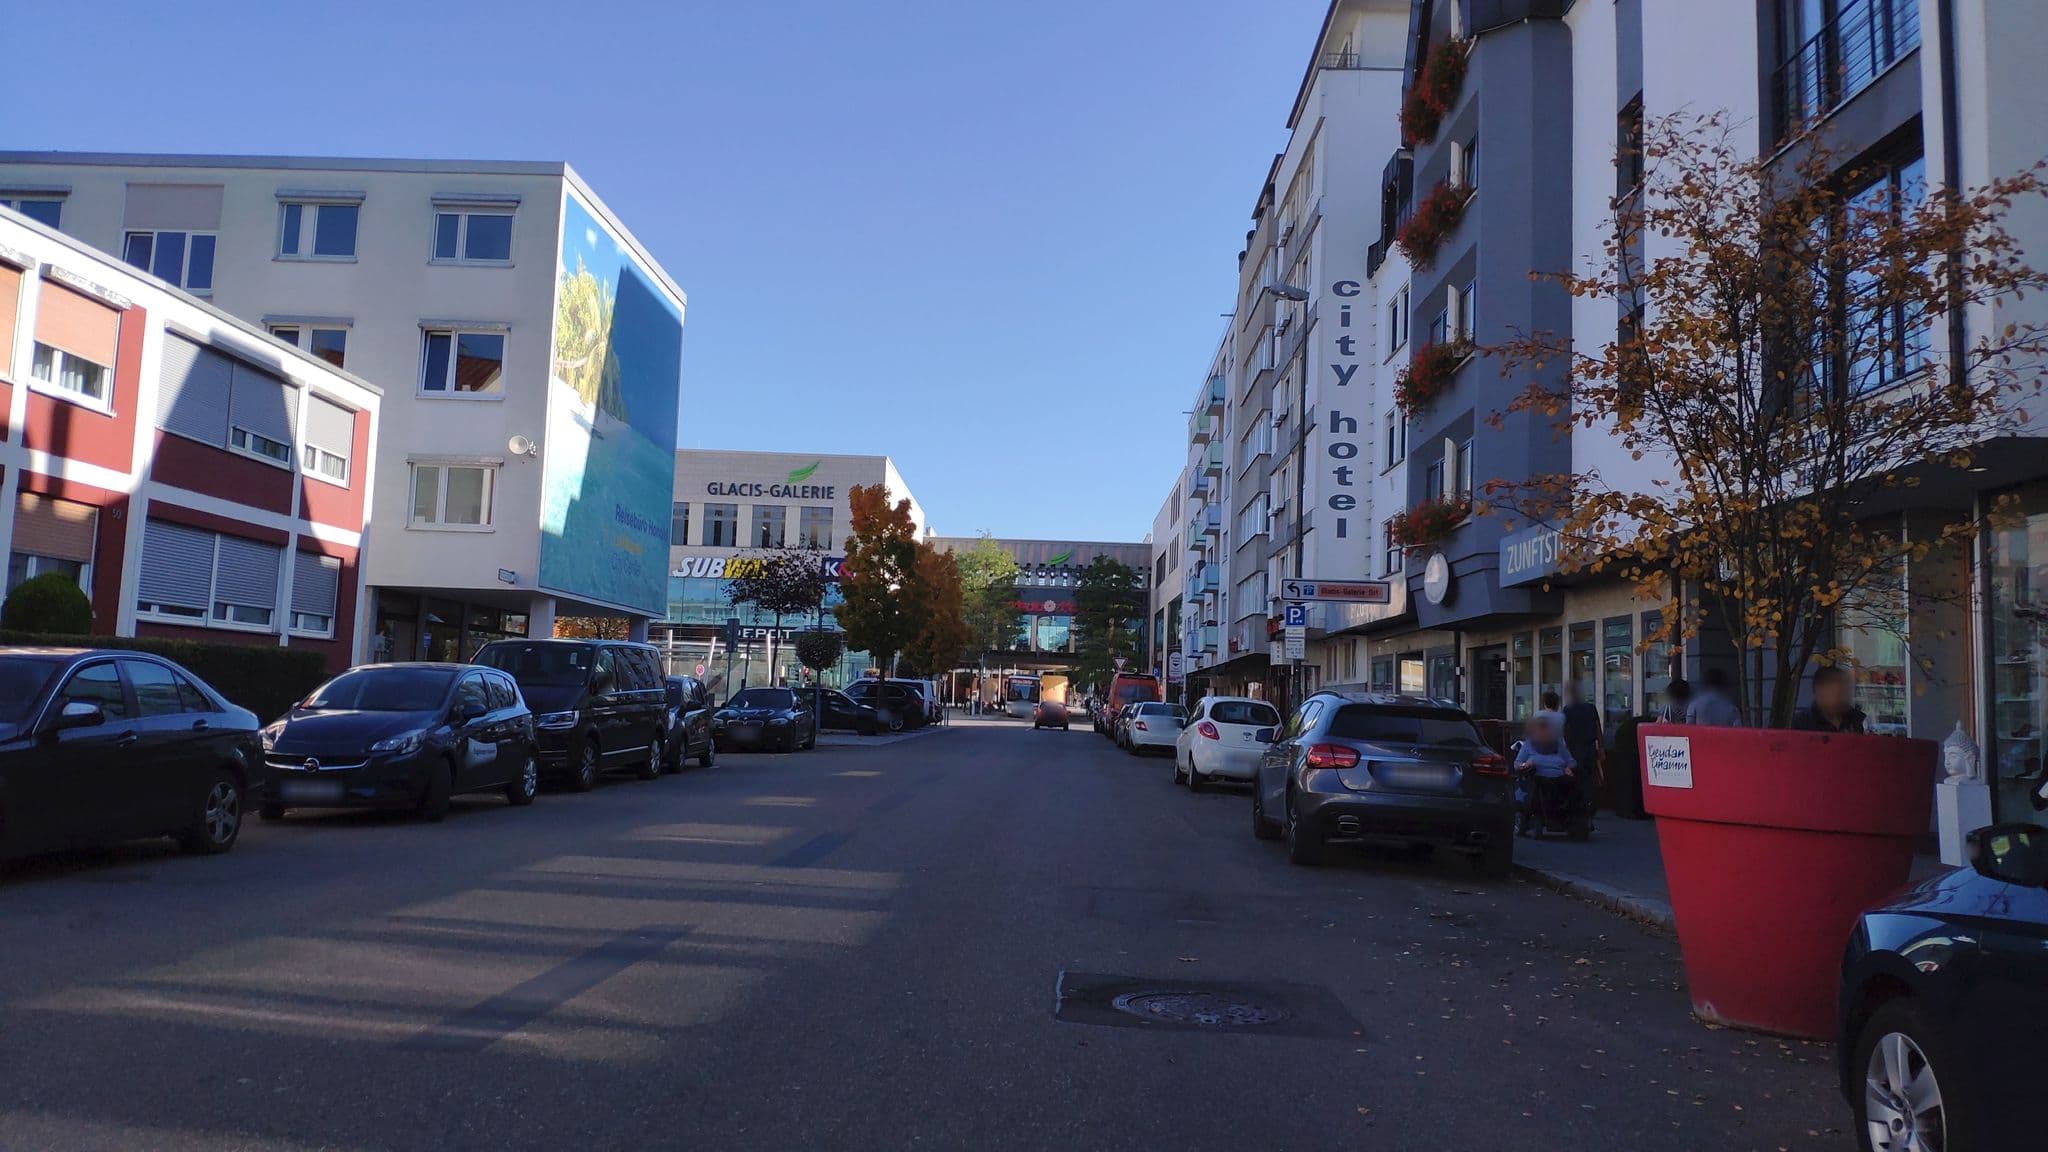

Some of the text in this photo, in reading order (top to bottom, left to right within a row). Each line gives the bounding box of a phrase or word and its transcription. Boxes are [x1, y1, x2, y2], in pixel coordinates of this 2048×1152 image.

[1328, 280, 1361, 538] city hotel
[707, 482, 835, 499] GLACIS-GALERIE
[736, 628, 791, 641] EPOT
